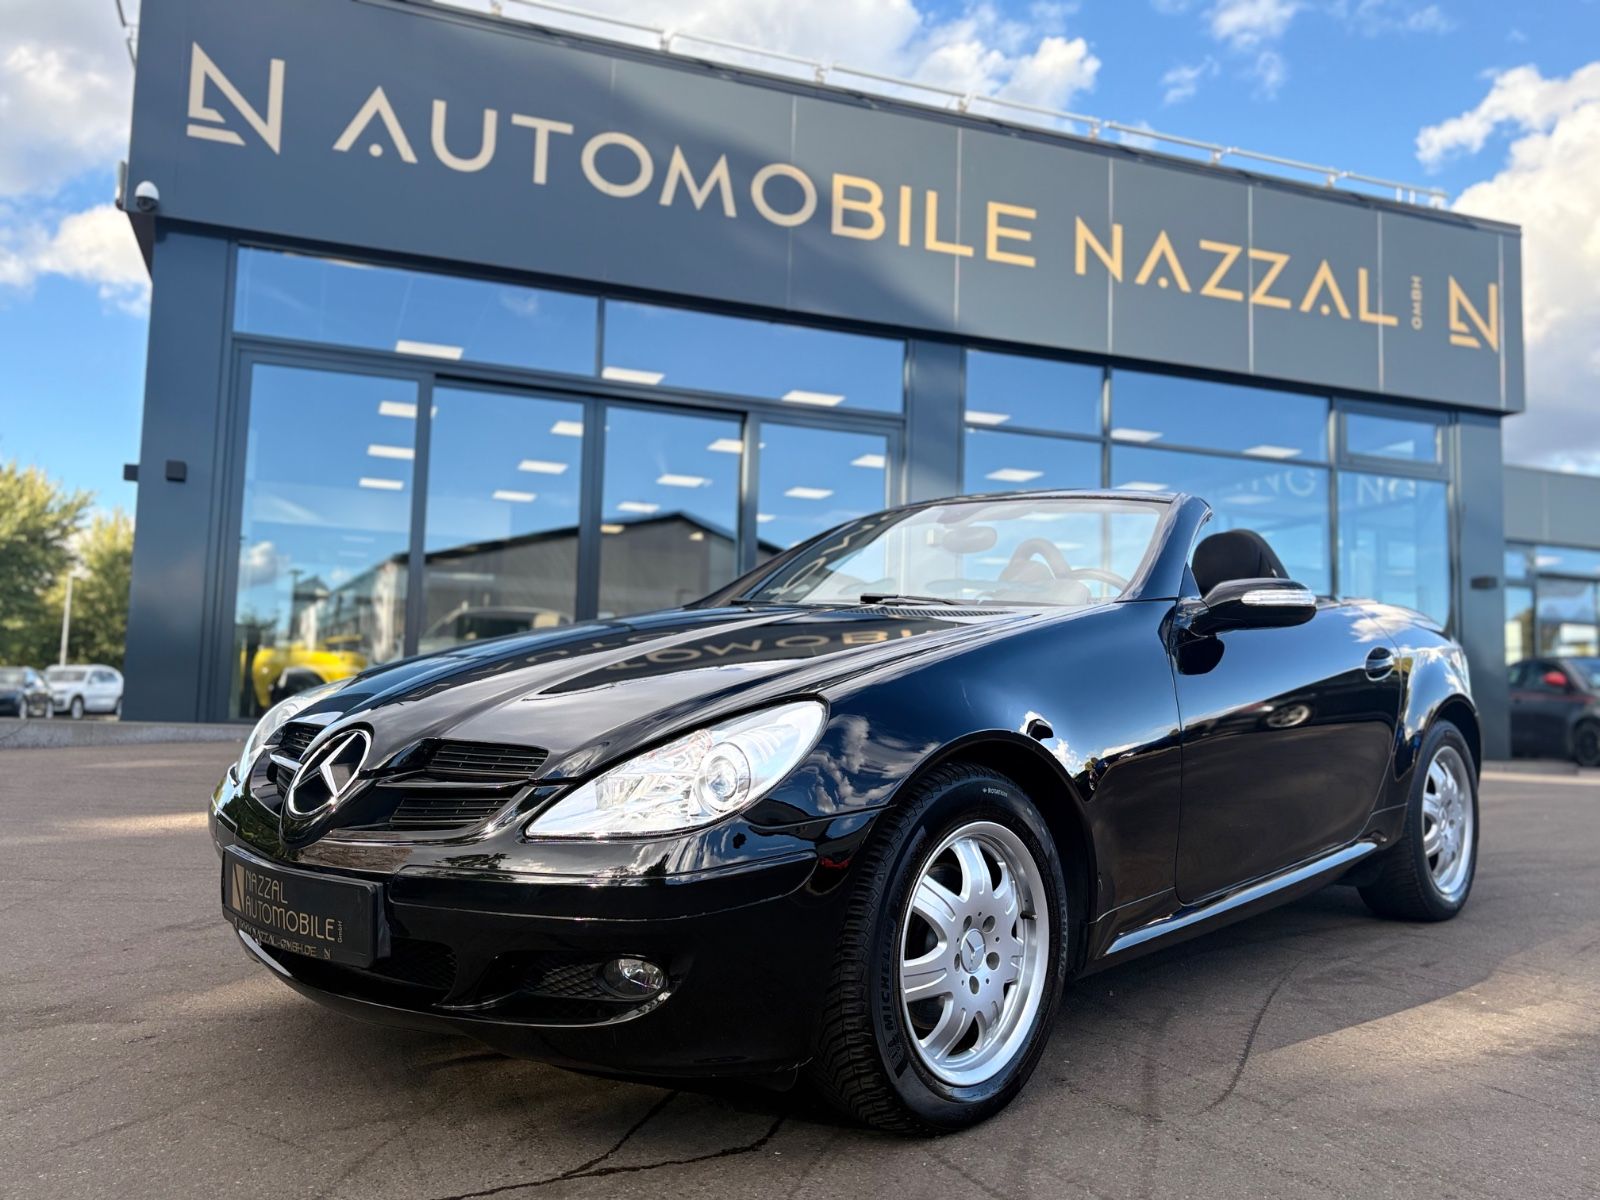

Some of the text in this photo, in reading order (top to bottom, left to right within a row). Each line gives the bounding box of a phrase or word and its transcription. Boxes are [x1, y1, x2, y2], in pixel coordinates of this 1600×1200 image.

[332, 86, 1036, 268] AUTOMOBILE
[1075, 216, 1398, 326] NAZZAL
[245, 870, 288, 904] NAZZAL
[245, 896, 335, 941] AUTOMOBILE
